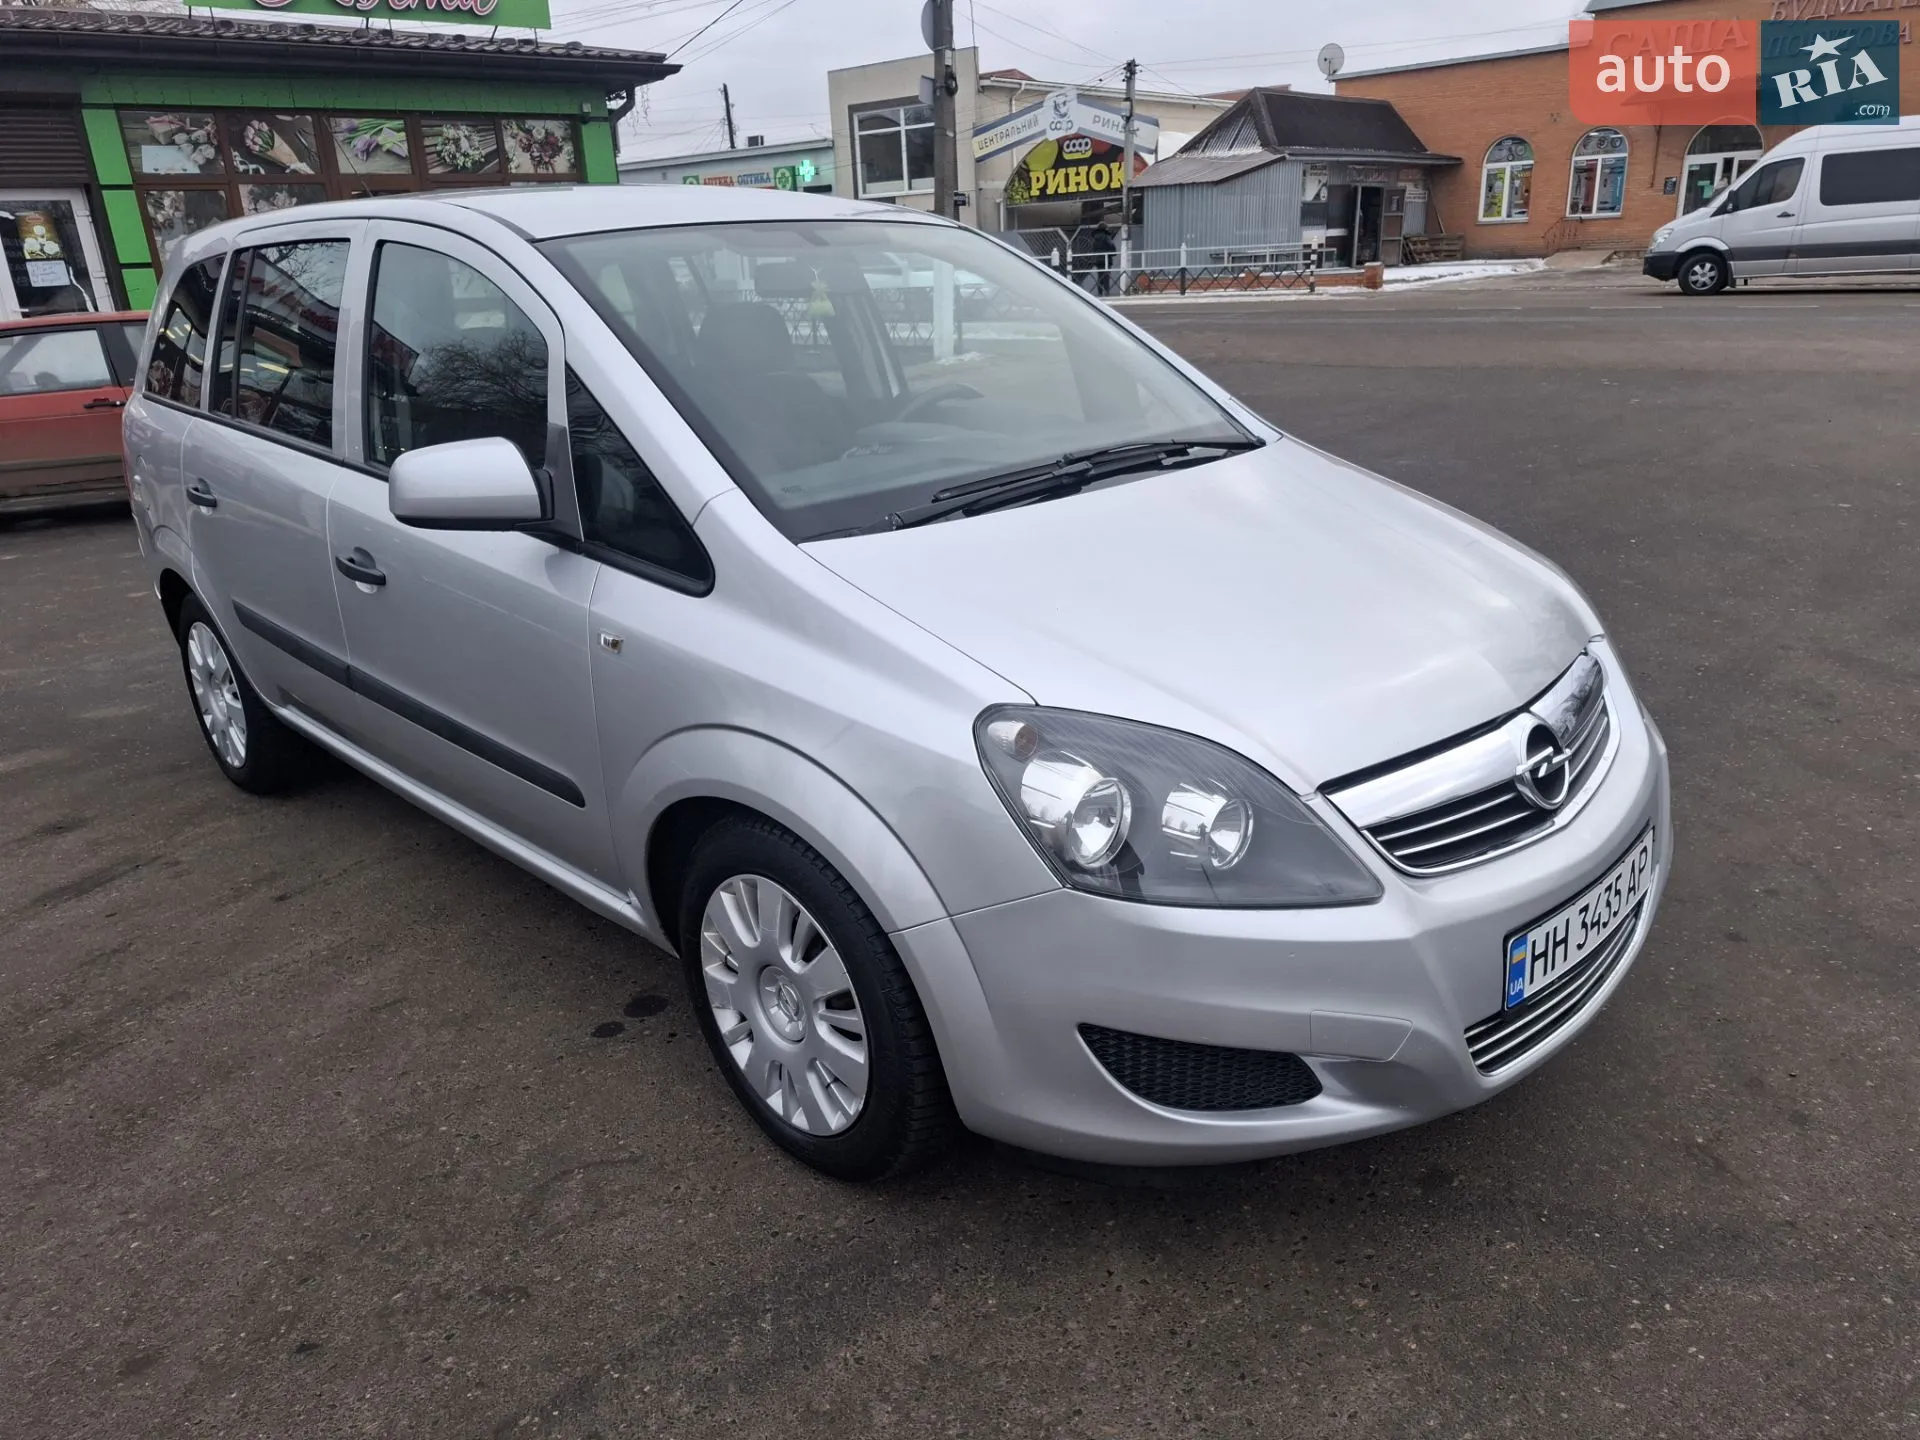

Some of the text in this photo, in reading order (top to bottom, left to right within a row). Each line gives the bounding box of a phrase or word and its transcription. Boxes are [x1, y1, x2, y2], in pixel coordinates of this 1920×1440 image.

[1769, 0, 1920, 26] БУДМА
[977, 114, 1040, 151] ЦЕНТРАЛЬНИЙ
[1091, 114, 1138, 138] РИН
[703, 172, 771, 187] АПТЕКА ОПТИКА
[1029, 162, 1126, 197] РИНОК
[1529, 844, 1648, 985] HH 3435 AP
[1510, 977, 1524, 995] UA
